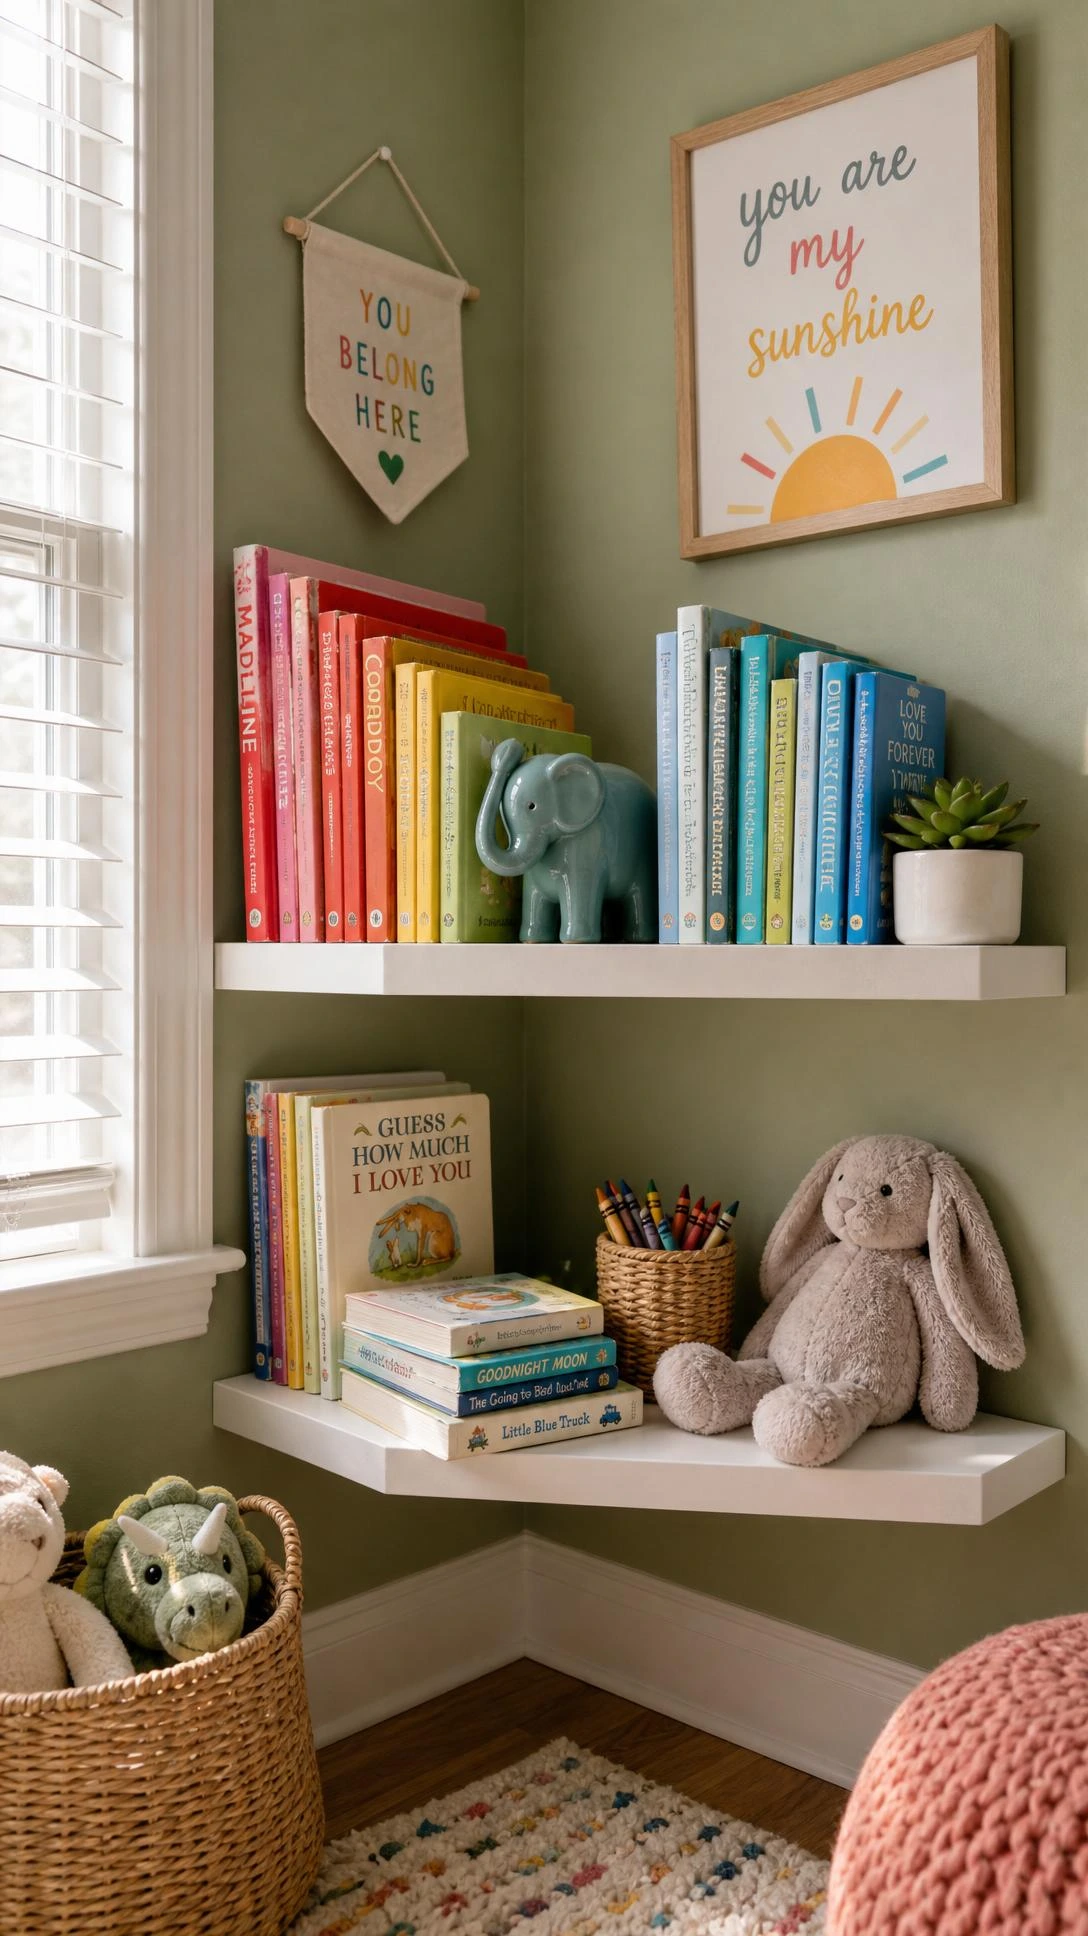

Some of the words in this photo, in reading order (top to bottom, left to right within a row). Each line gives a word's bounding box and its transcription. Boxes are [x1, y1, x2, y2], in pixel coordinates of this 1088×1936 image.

[739, 174, 822, 267] you
[841, 144, 917, 193] are
[789, 225, 865, 290] my
[359, 288, 411, 337] YOU
[747, 287, 934, 378] sunshine
[339, 335, 435, 396] BELONG
[355, 393, 421, 443] HERE
[900, 699, 927, 725] LOVE
[902, 720, 924, 742] YOU
[887, 740, 935, 769] FOREVER
[378, 1112, 446, 1138] GUESS
[351, 1142, 404, 1167] HOW
[408, 1134, 471, 1161] MUCH
[352, 1173, 362, 1195] I
[368, 1166, 424, 1193] LOVE
[429, 1160, 472, 1184] YOU
[477, 1359, 549, 1383] GOODNIGHT
[552, 1352, 588, 1371] MOON
[489, 1390, 519, 1406] Going
[520, 1388, 532, 1400] to
[501, 1424, 532, 1440] Little
[534, 1418, 558, 1434] Blue
[559, 1412, 590, 1429] Truck
